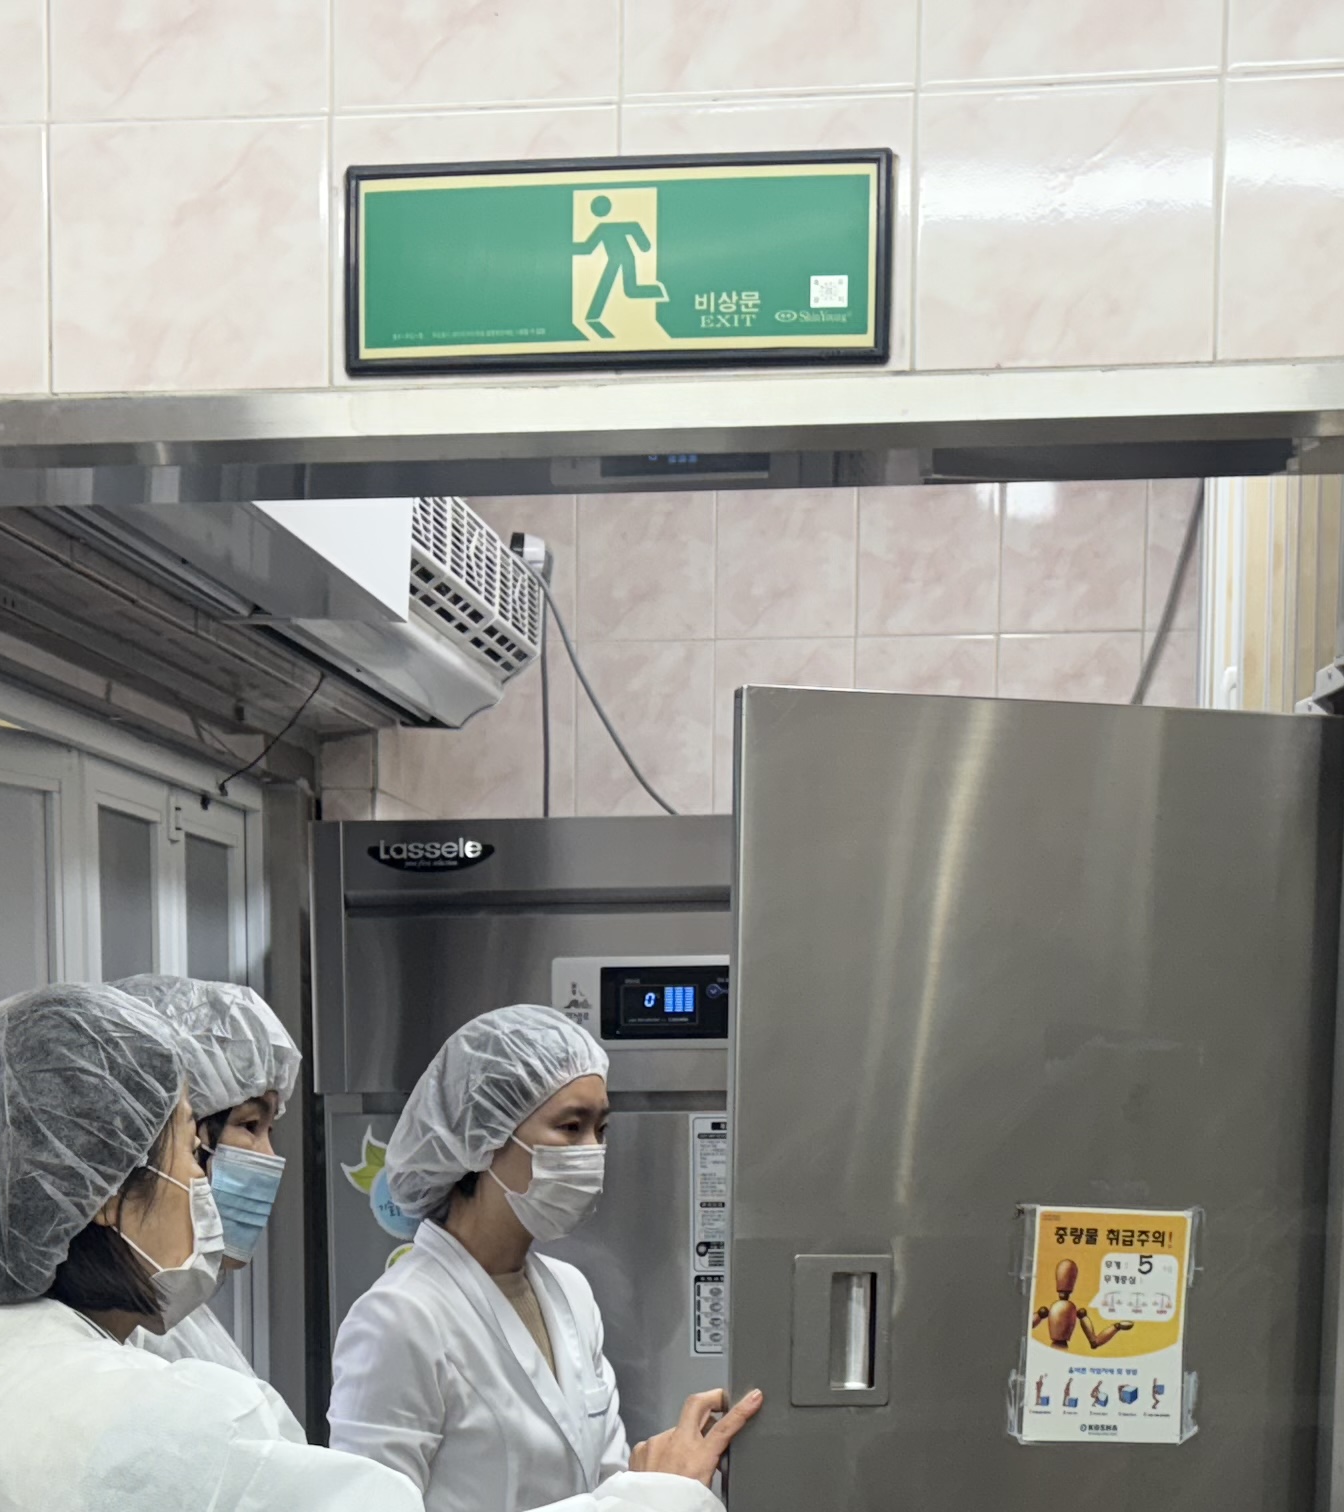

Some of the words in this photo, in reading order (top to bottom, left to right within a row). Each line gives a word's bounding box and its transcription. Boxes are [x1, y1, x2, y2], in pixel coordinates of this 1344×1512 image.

[694, 291, 761, 313] 비상문
[700, 314, 757, 328] EXIT
[379, 837, 483, 860] Lassele
[1055, 1226, 1098, 1245] 중량물
[1106, 1228, 1173, 1249] 취급주의!
[1138, 1254, 1153, 1275] 5
